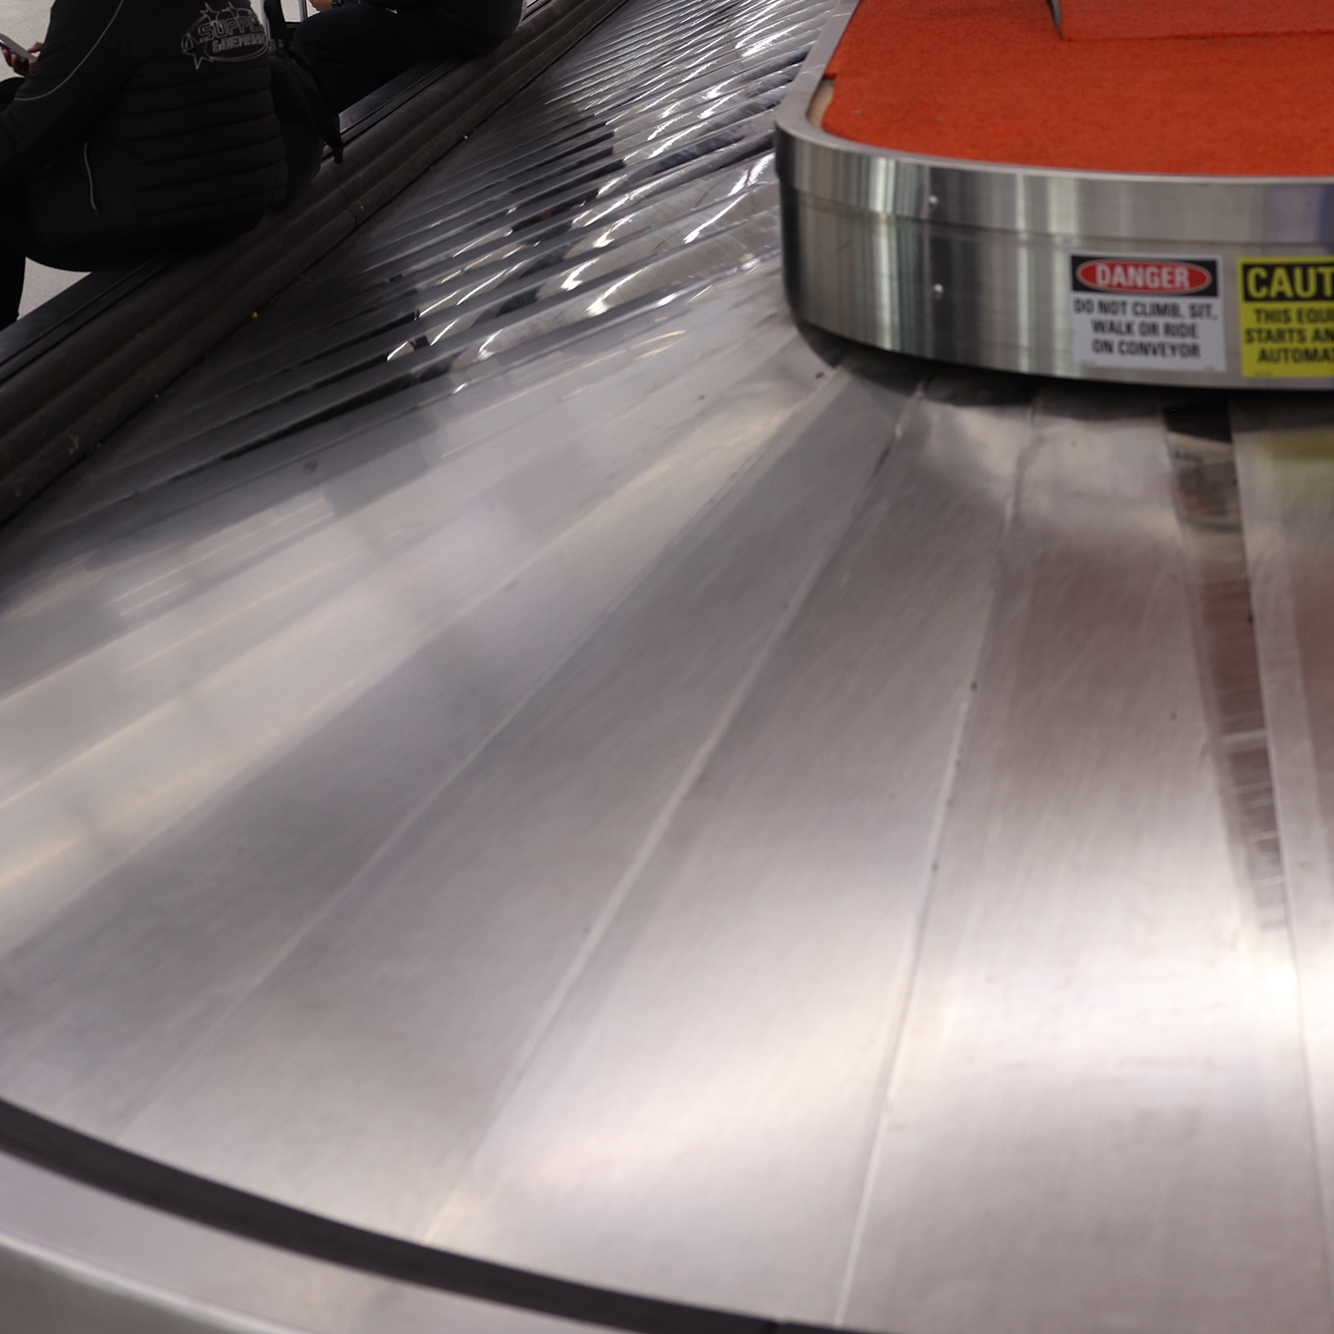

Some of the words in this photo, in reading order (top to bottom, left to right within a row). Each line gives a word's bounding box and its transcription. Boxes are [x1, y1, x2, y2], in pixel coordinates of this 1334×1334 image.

[1095, 263, 1191, 290] DANGER
[1073, 299, 1095, 314] DO
[1098, 299, 1127, 315] NOT
[1188, 303, 1218, 321] SIT,
[1255, 308, 1292, 324] THIS
[1091, 319, 1134, 335] WALK
[1138, 321, 1159, 337] OR
[1163, 322, 1198, 339] RIDE
[1244, 327, 1307, 344] STARTS
[1091, 338, 1113, 355] ON
[1117, 339, 1201, 359] CONVEYOR
